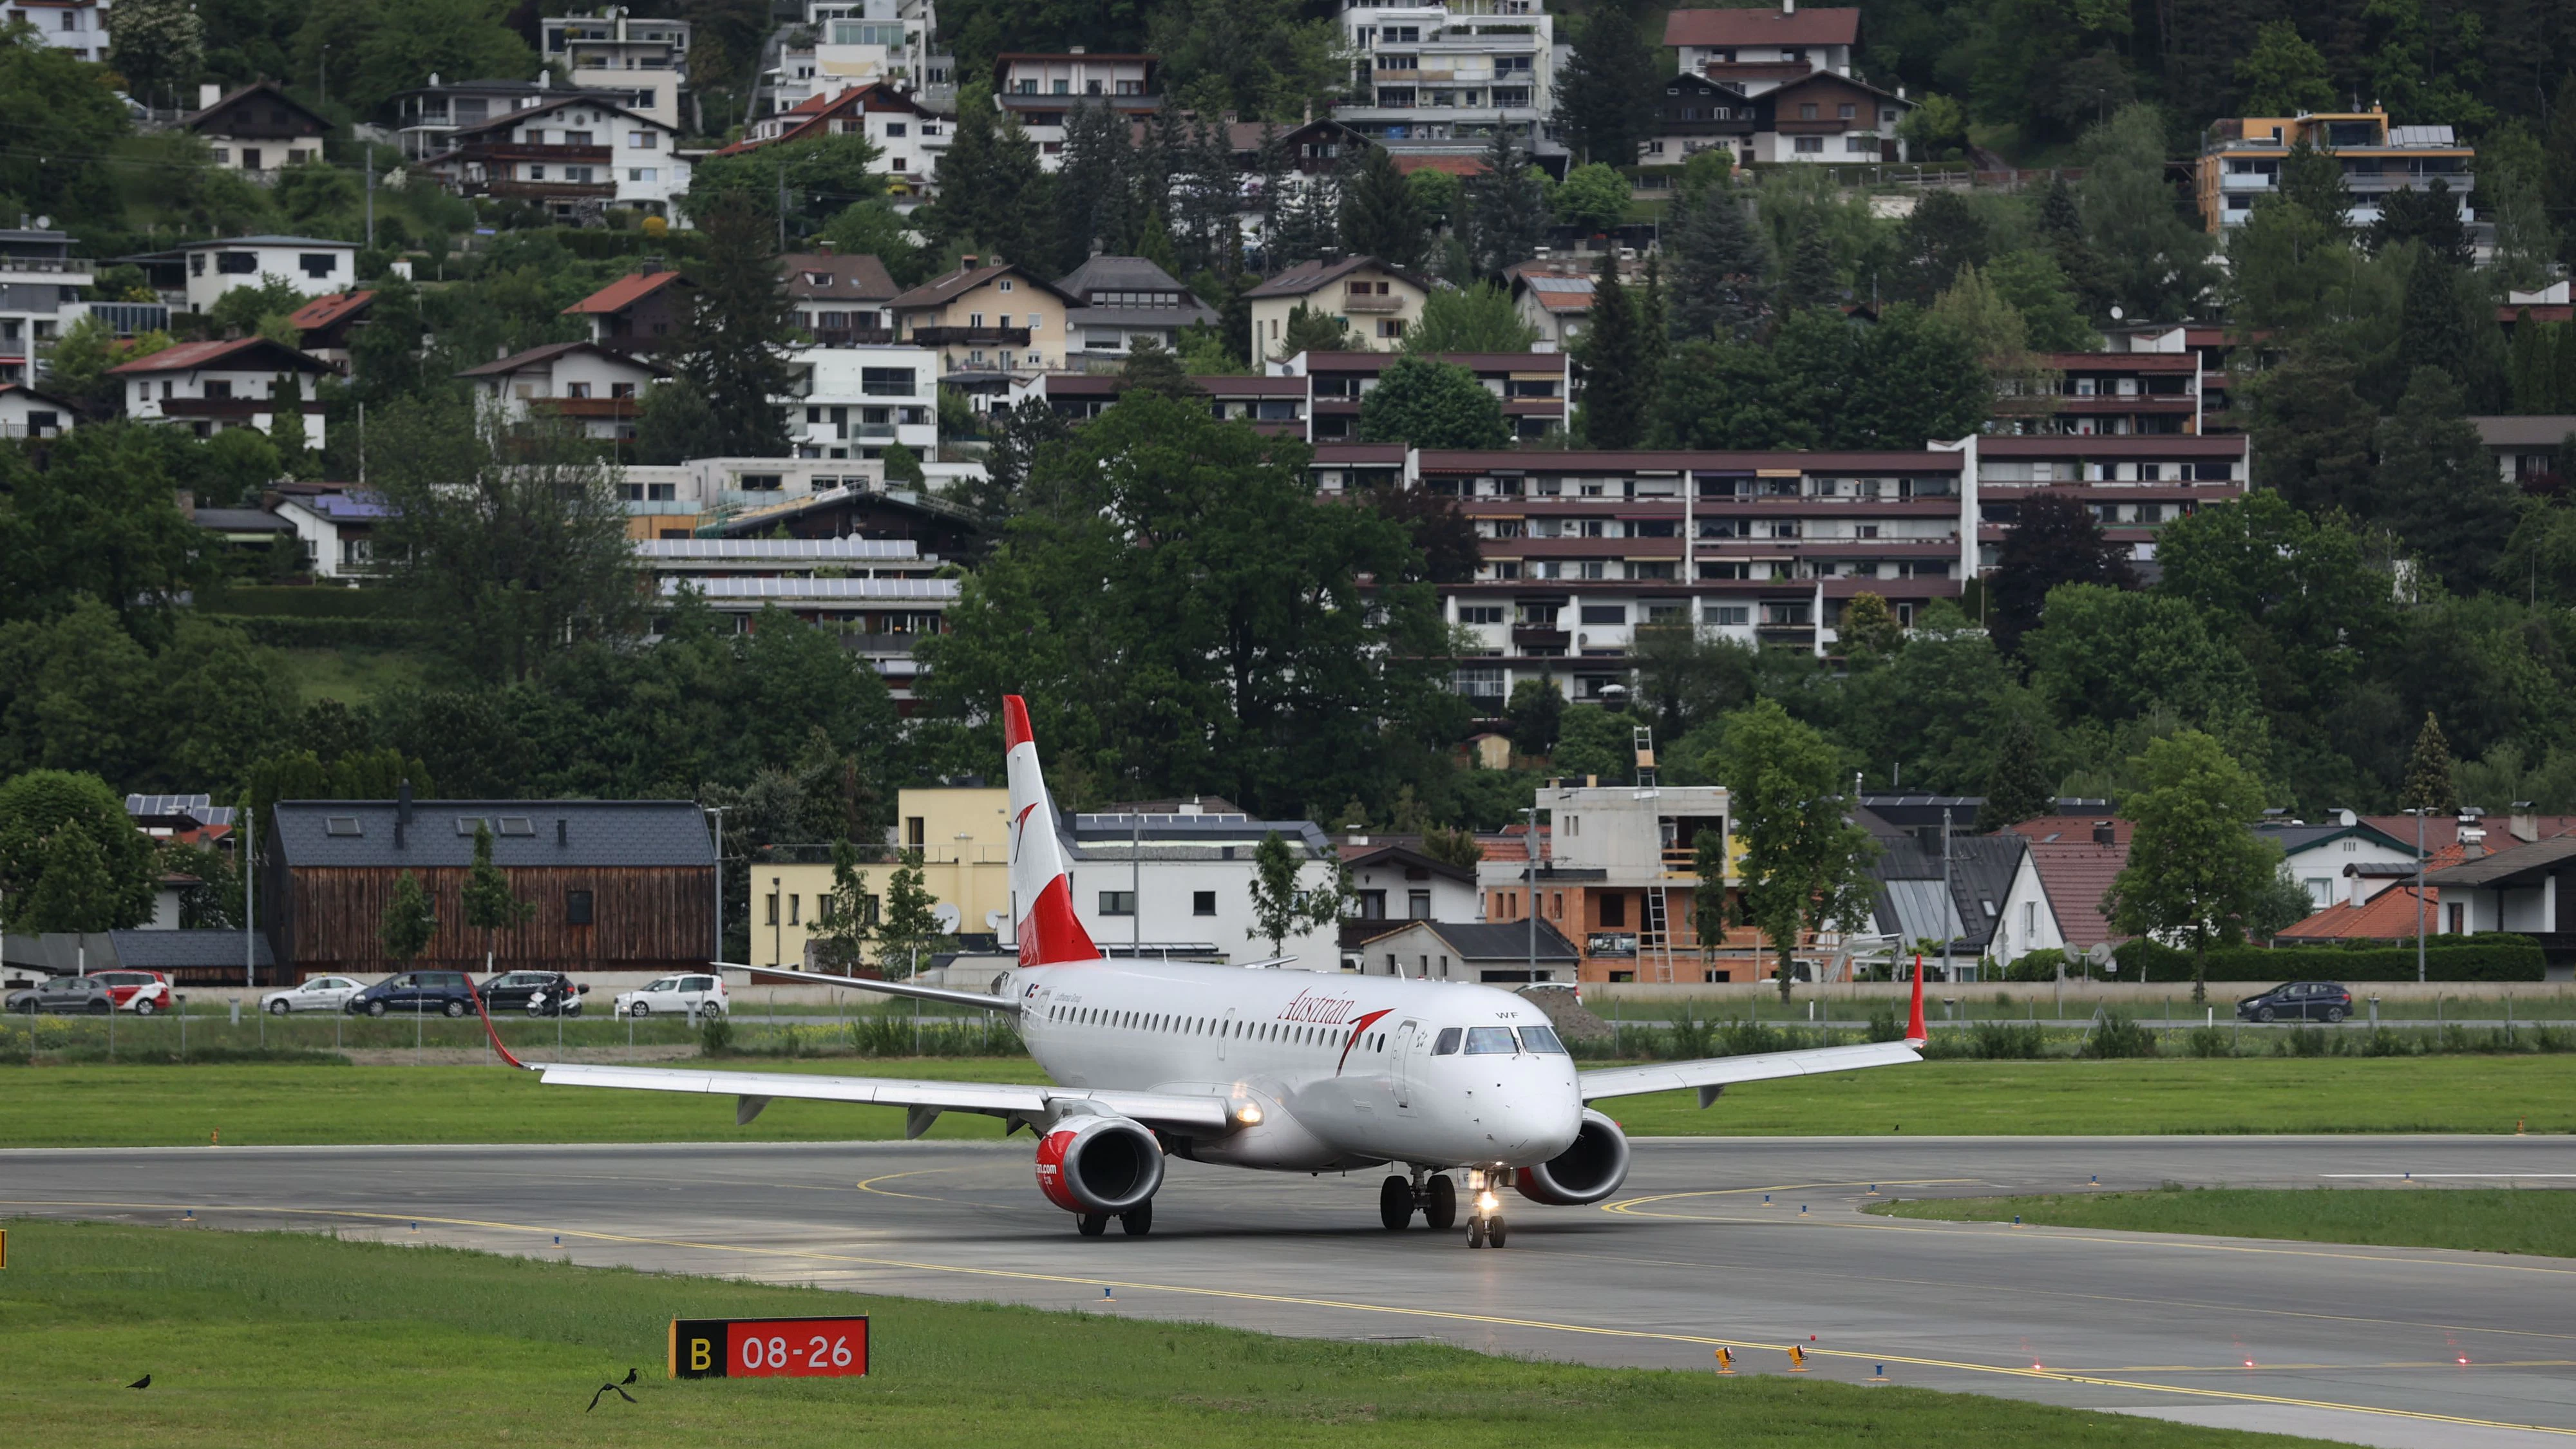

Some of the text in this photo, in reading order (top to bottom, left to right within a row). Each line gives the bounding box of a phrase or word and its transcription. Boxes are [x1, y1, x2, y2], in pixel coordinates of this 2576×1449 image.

[1277, 986, 1354, 1024] Austrian
[691, 1336, 852, 1370] B 08-26
